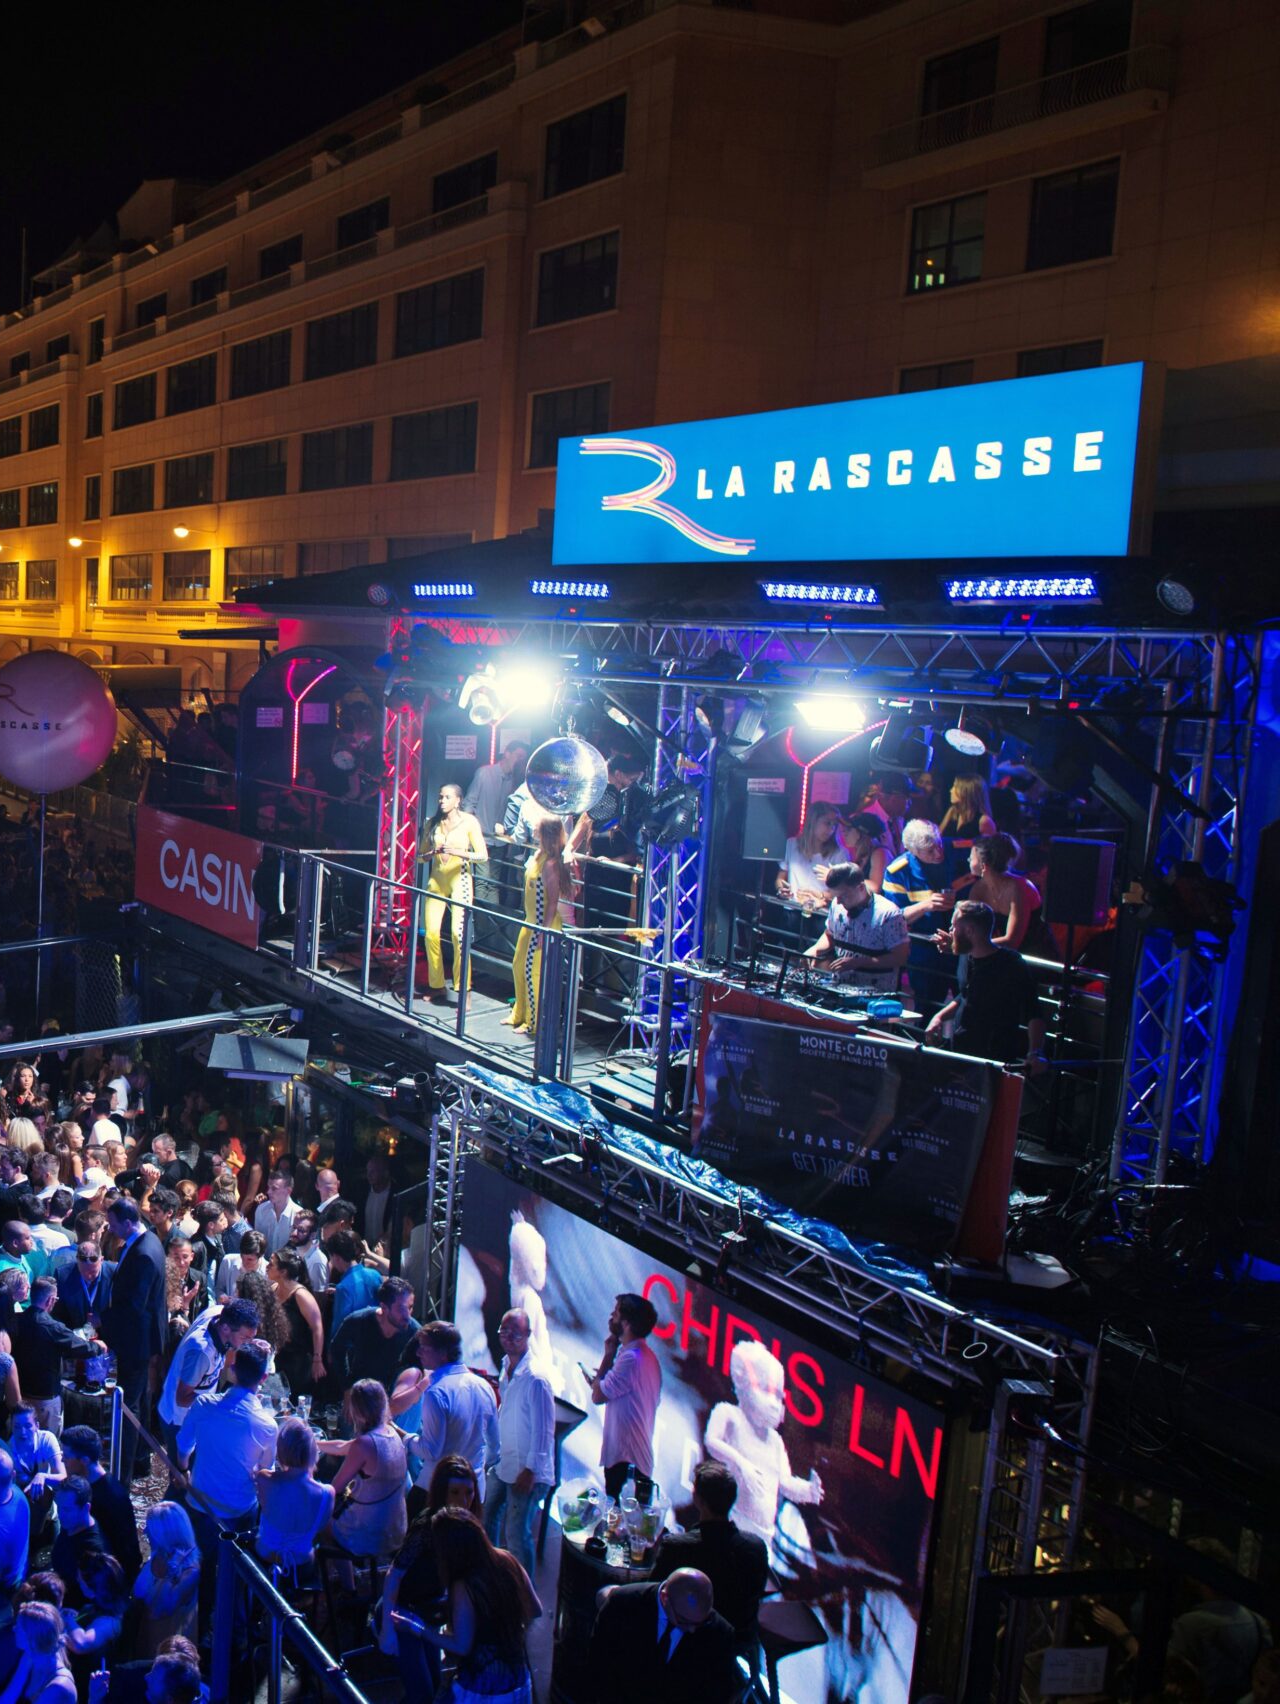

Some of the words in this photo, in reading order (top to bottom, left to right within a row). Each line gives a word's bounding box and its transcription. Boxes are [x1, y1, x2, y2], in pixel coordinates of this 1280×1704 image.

[696, 466, 746, 500] LA
[773, 431, 1105, 494] RASCASSE
[778, 1127, 796, 1141] LA
[792, 1152, 817, 1174] GET
[848, 1383, 944, 1501] LN
